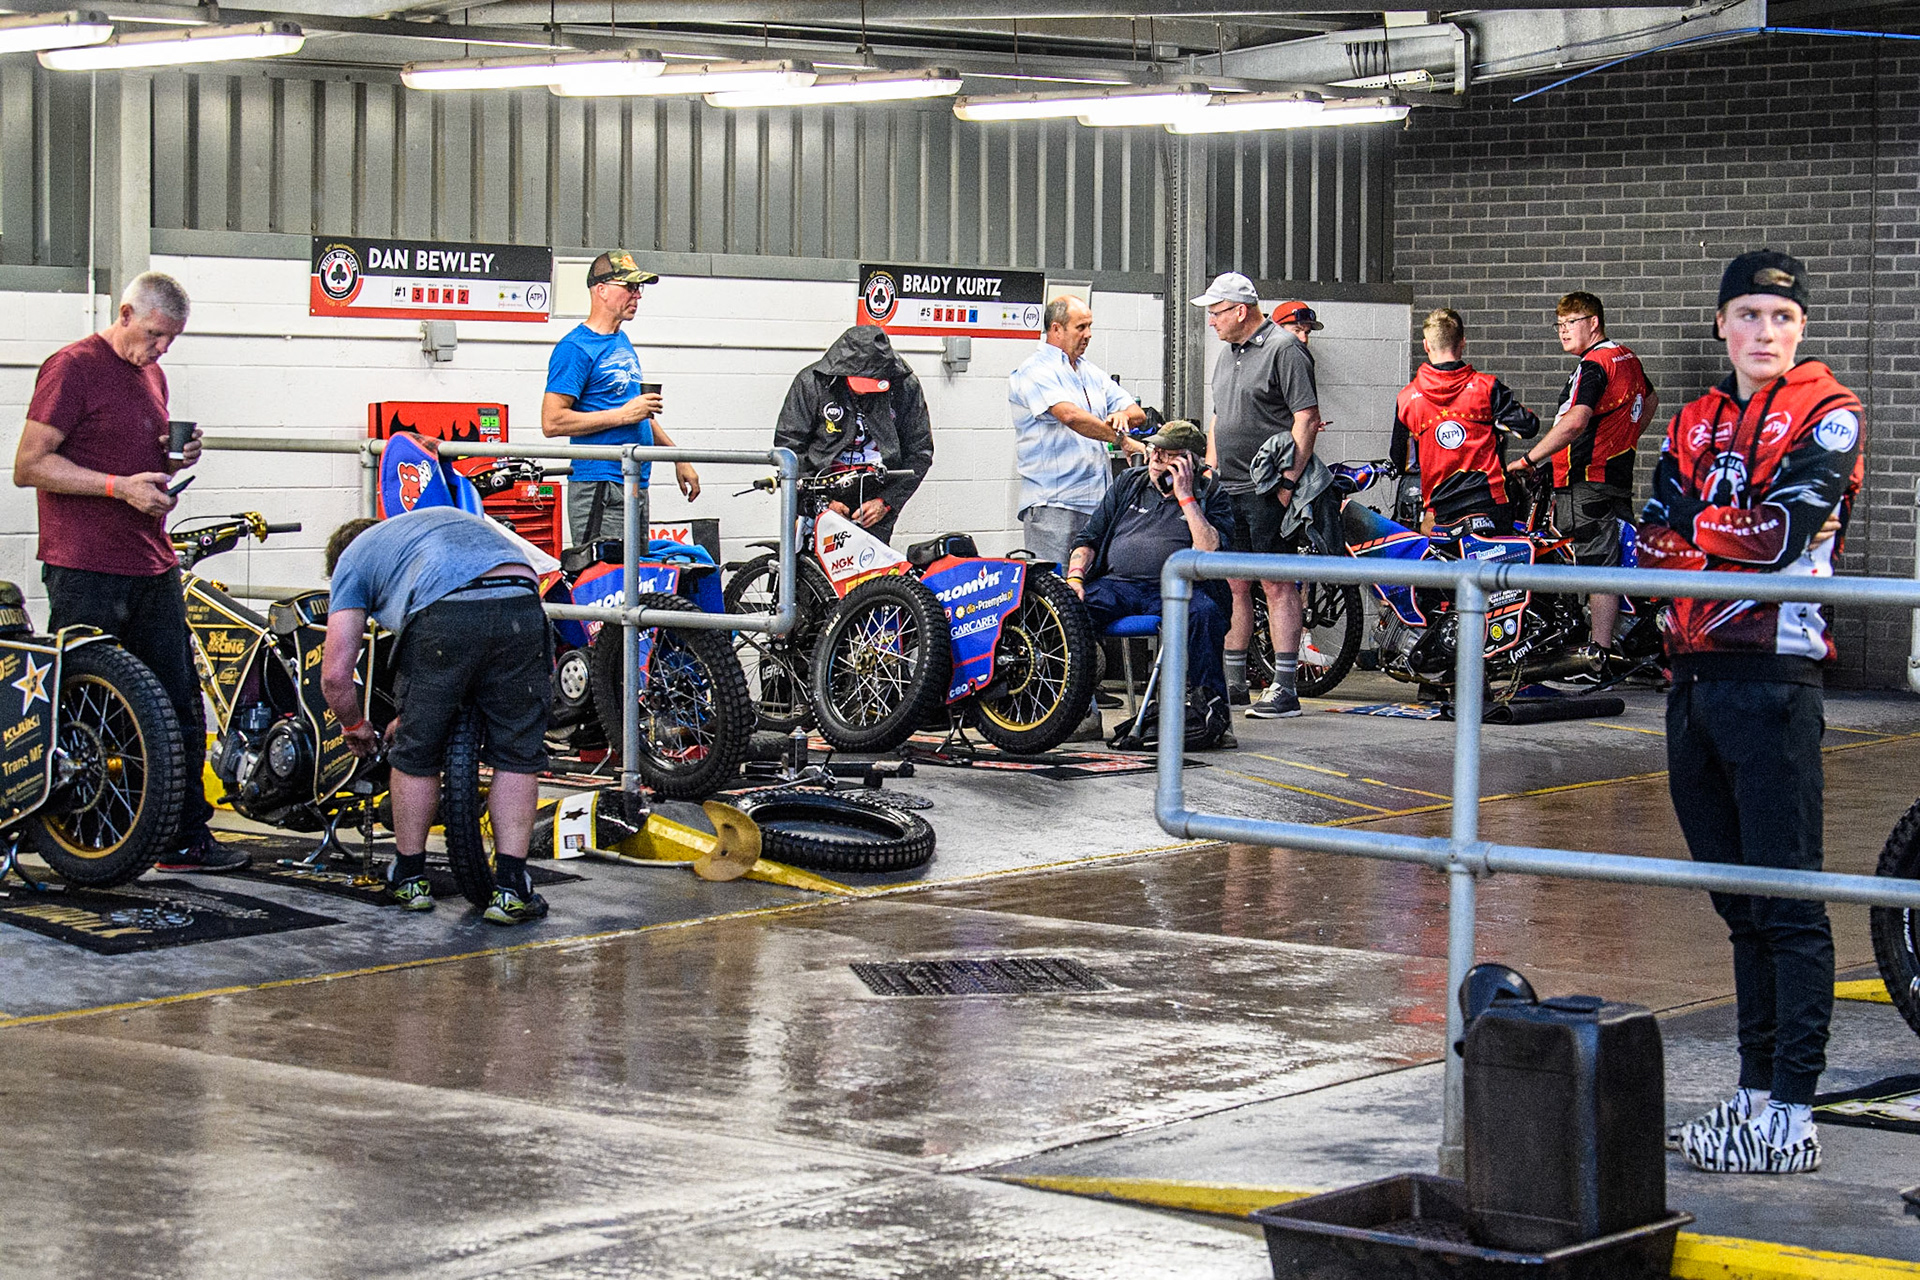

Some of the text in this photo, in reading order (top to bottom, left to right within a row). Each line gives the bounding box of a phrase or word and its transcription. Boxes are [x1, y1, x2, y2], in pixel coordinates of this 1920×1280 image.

[368, 247, 495, 273] DAN BEWLEY
[394, 286, 406, 297] #1
[415, 289, 420, 300] 3
[445, 291, 451, 301] 4
[460, 291, 466, 302] 2
[902, 274, 1002, 296] BRADY KURTZ
[529, 292, 543, 301] ATPI
[920, 307, 931, 317] #5
[481, 416, 500, 428] 99
[1822, 420, 1852, 440] ATPI
[1441, 429, 1460, 441] ATPI
[831, 555, 854, 571] NGK
[665, 571, 675, 590] 1
[1011, 566, 1022, 583] 1
[936, 571, 1001, 603] PLOMYK
[950, 612, 999, 638] GARCAREK
[1514, 645, 1529, 660] ATPI
[322, 734, 344, 754] Trans
[2, 755, 29, 777] Trans
